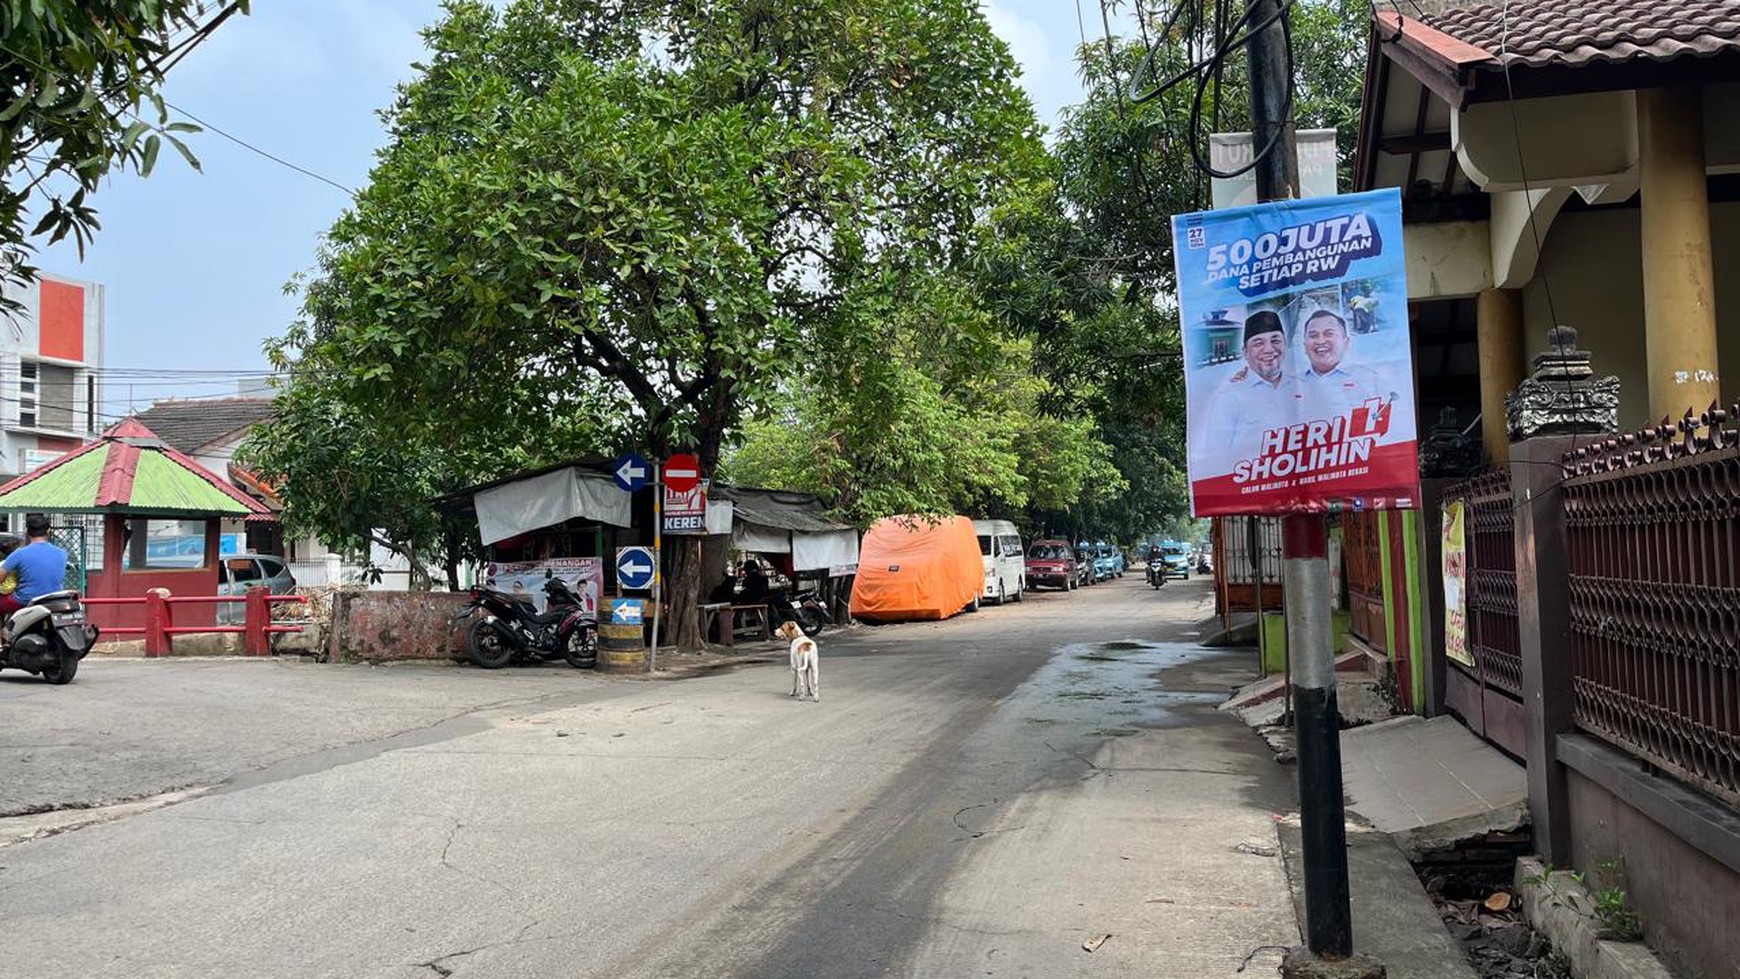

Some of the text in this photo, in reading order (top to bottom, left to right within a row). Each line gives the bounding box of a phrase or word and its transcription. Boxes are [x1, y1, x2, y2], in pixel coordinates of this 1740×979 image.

[1189, 228, 1203, 239] 27
[1207, 236, 1372, 282] DANA PEMBANGUNAN
[1238, 254, 1342, 290] SETIAP RW
[1261, 416, 1344, 456] HERI
[1233, 438, 1372, 484] SHOLIHIN
[664, 516, 705, 530] KEREN
